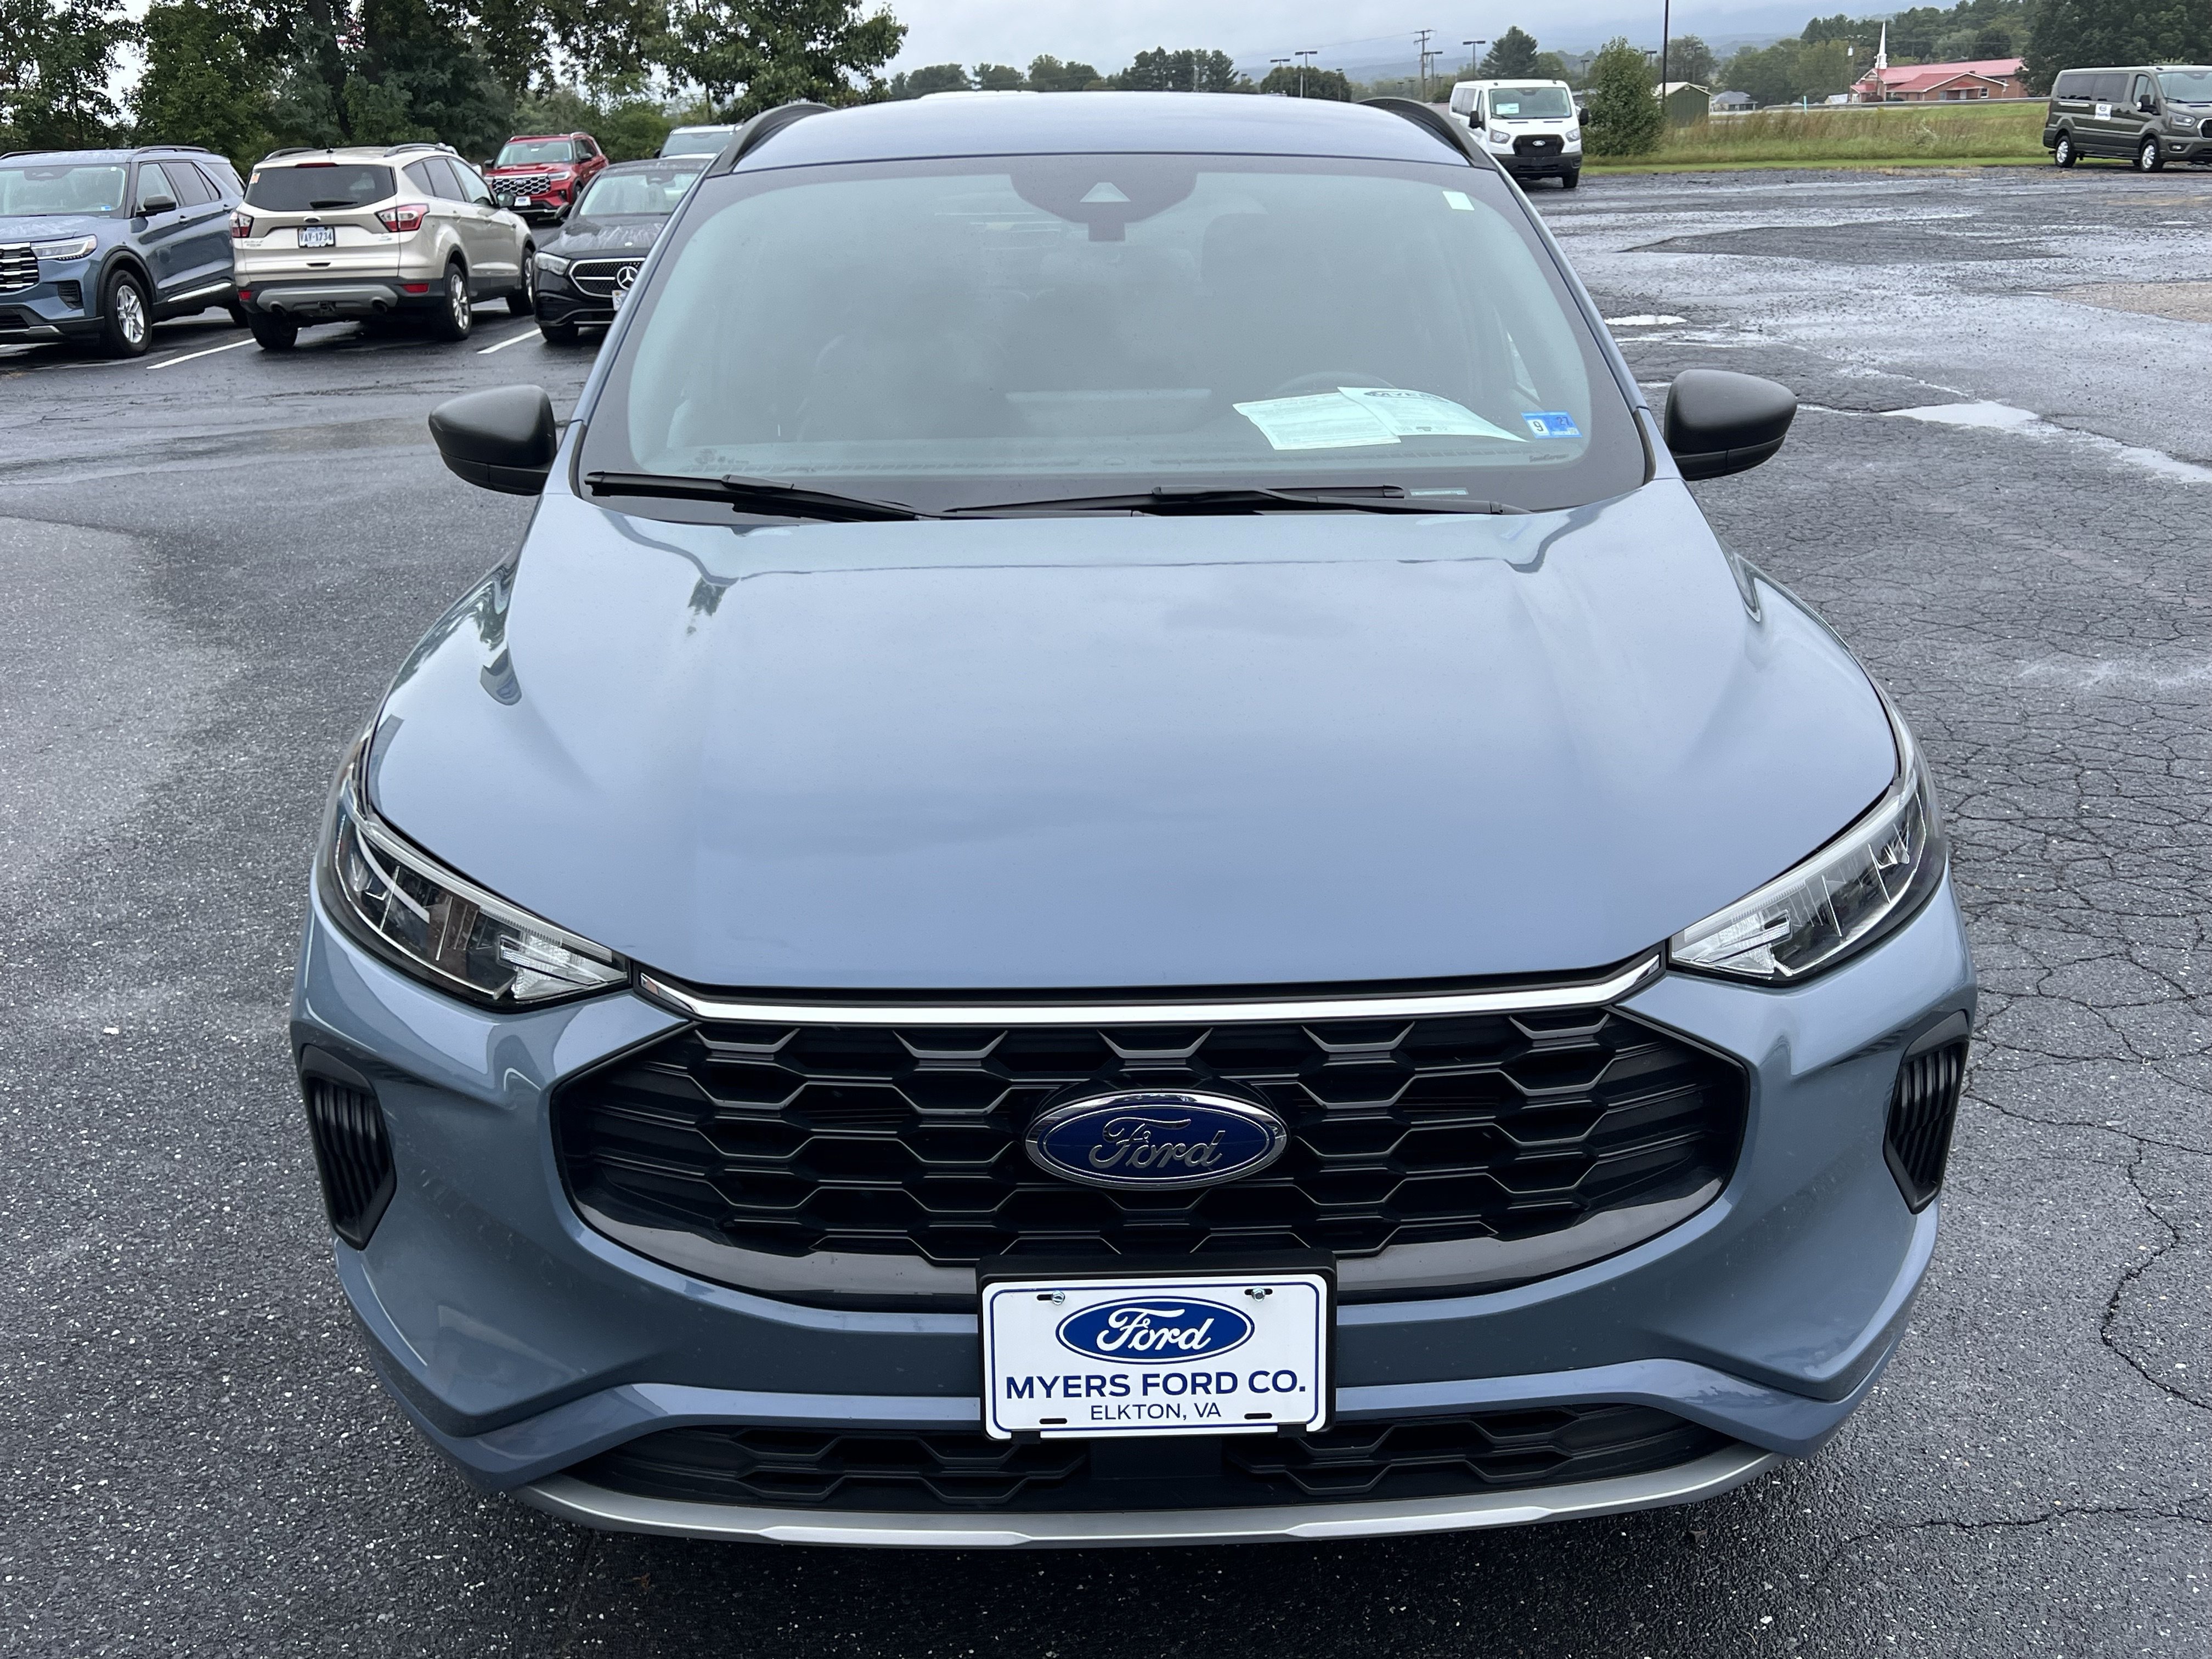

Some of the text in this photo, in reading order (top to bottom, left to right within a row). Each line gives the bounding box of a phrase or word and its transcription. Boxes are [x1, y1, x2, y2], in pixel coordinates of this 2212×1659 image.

[1533, 421, 1544, 432] 9
[1556, 416, 1570, 426] 27
[1088, 1116, 1226, 1169] Ford
[1096, 1307, 1215, 1351] Ford
[1006, 1369, 1306, 1399] MYERS FORD CO.
[1091, 1402, 1222, 1421] ELKTON, VA
